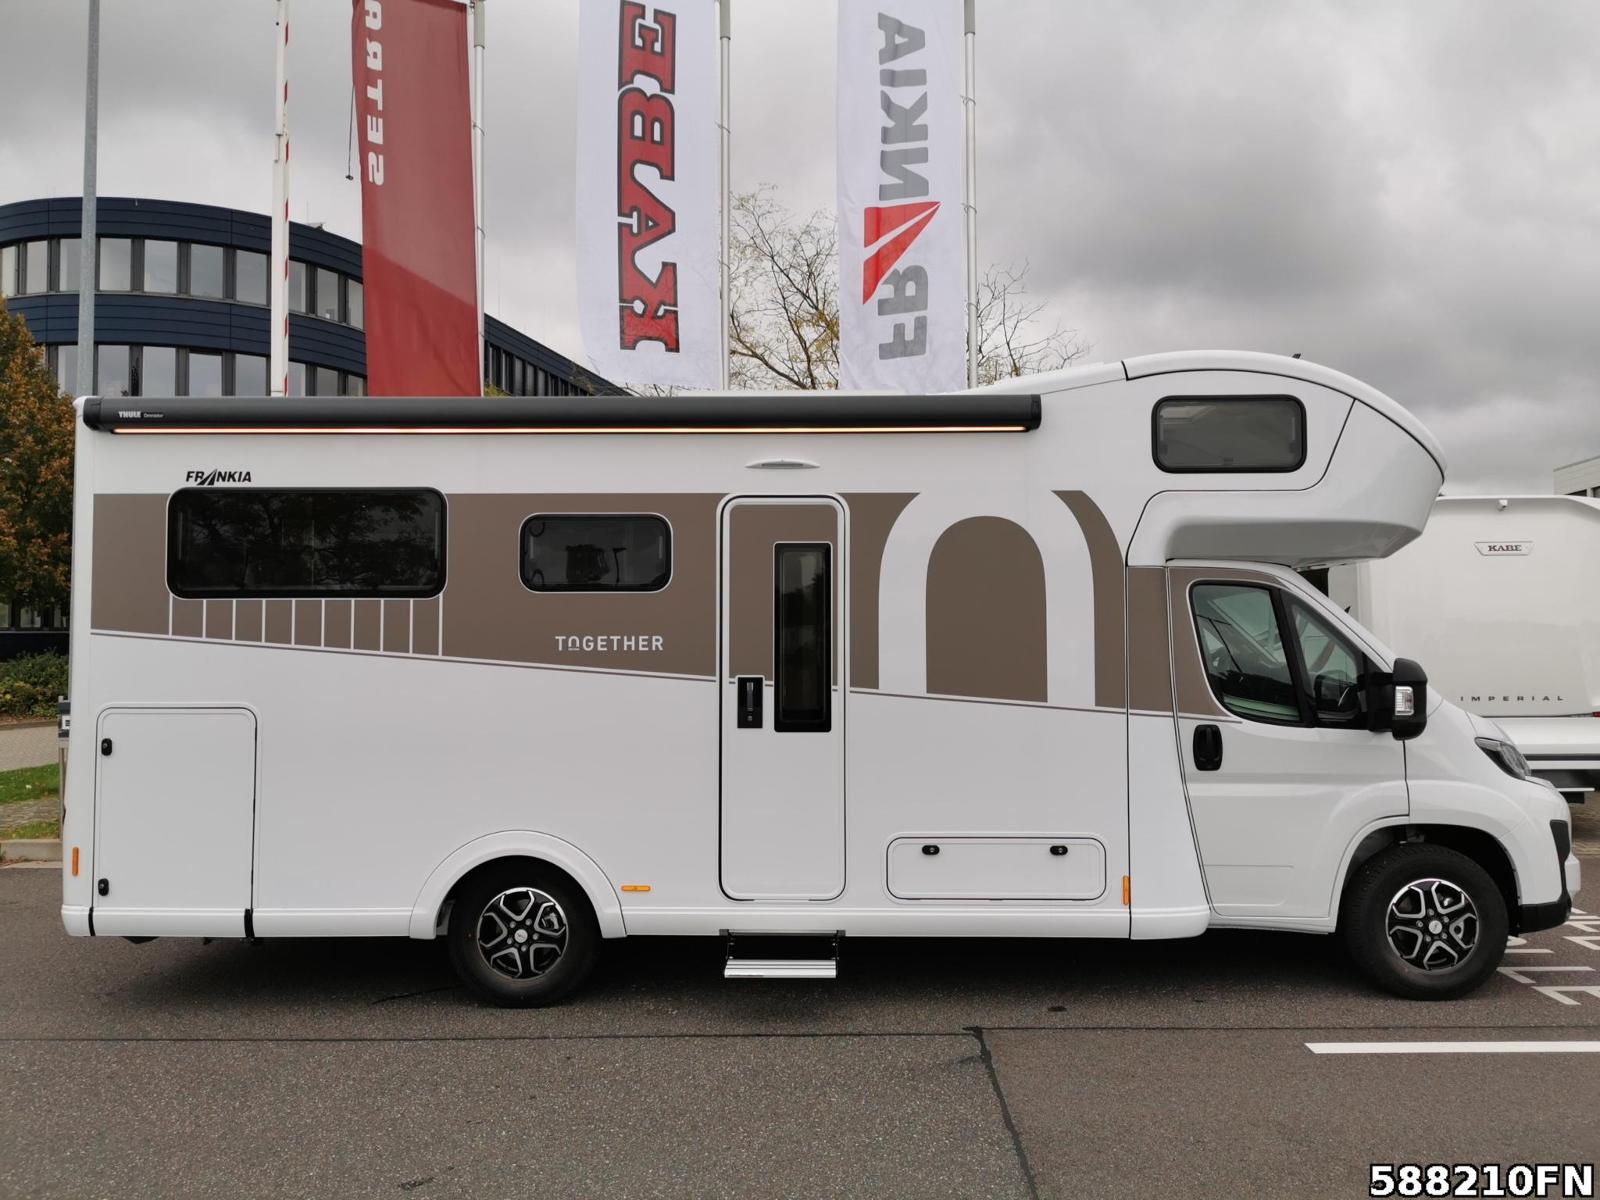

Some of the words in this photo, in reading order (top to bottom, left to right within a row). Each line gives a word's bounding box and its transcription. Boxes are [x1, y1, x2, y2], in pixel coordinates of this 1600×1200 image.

[118, 410, 142, 419] THULE
[185, 468, 252, 486] FRANKIA
[1487, 544, 1522, 552] KABE
[555, 635, 664, 651] TOGETHER
